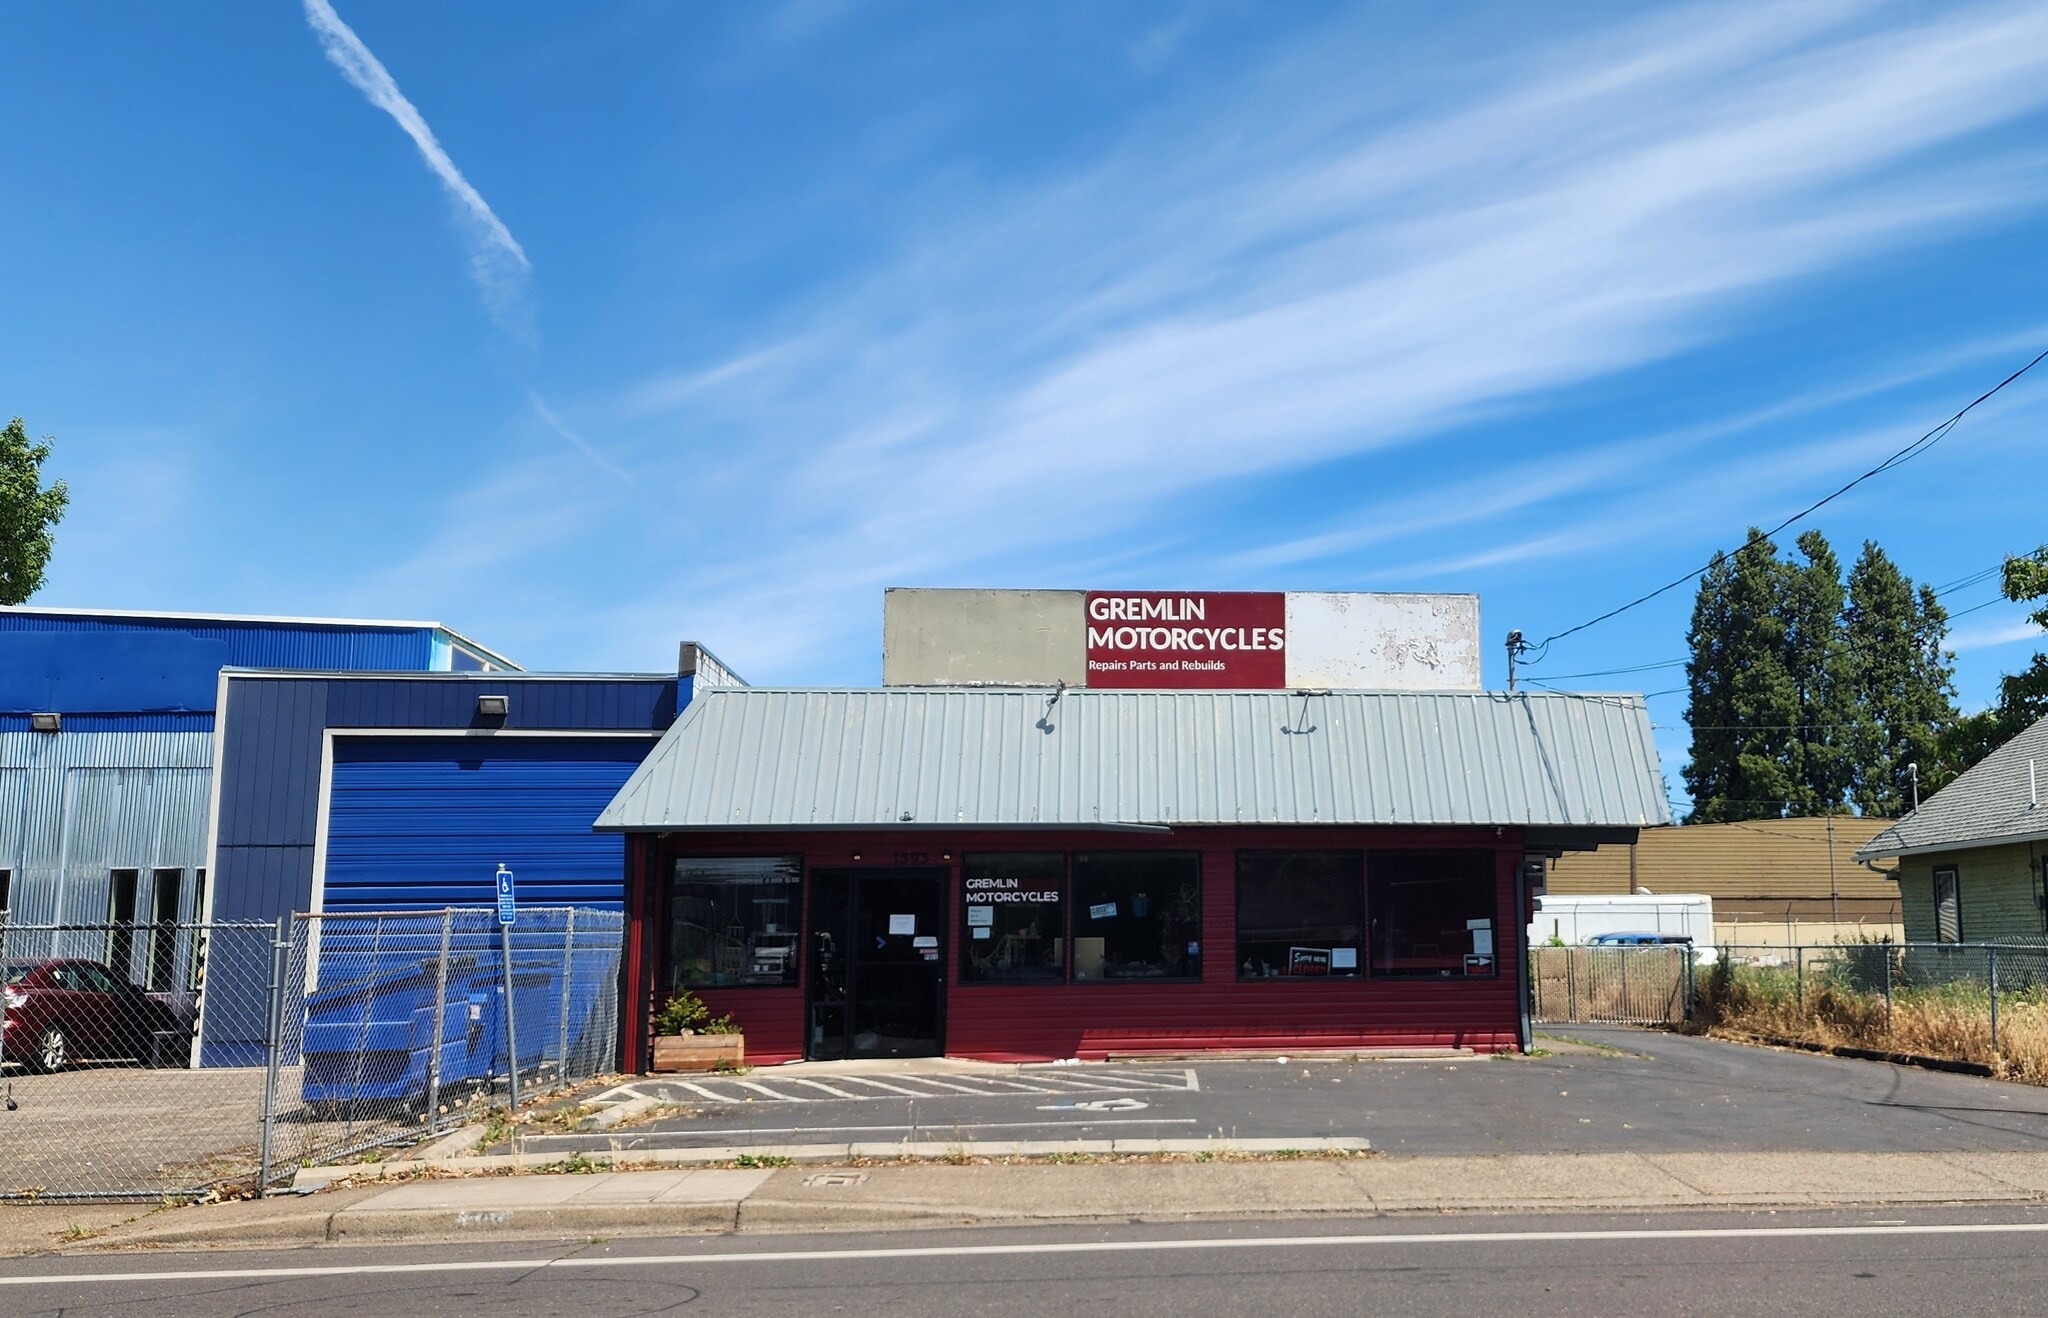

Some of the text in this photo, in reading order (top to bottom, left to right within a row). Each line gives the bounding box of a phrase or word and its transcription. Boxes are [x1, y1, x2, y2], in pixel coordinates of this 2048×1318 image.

[1089, 598, 1205, 620] GREMLIN
[1088, 627, 1284, 650] MOTORCYCLES
[1088, 660, 1226, 672] Repairs Parts and Rebuilds
[965, 878, 1018, 889] GREMLIN
[966, 891, 1059, 902] MOTORCYCLES
